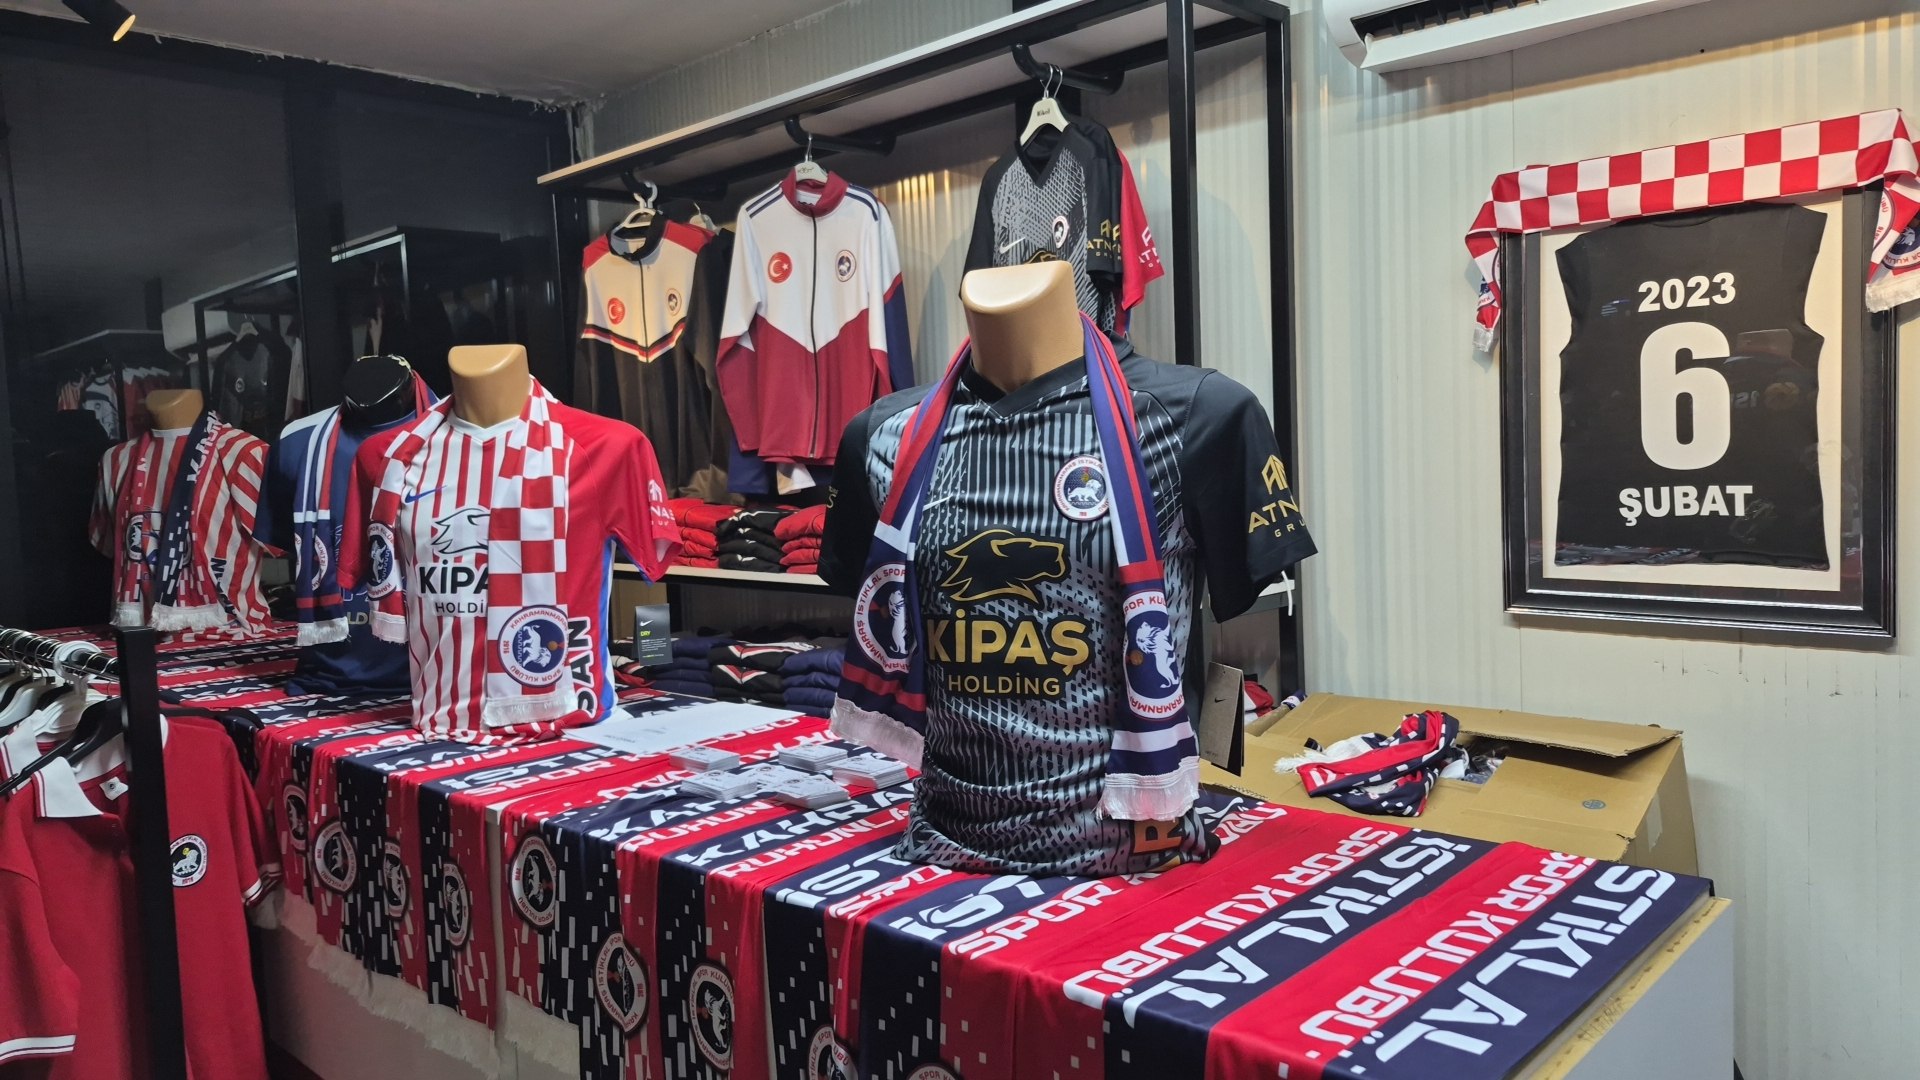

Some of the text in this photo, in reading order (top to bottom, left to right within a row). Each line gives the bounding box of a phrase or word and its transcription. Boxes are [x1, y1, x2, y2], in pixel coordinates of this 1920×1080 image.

[1637, 272, 1737, 313] 2023
[1640, 321, 1731, 471] 6
[1248, 495, 1300, 534] ATN
[1618, 485, 1753, 527] ŞUBAT
[418, 558, 489, 595] KİPA
[434, 599, 485, 614] HOLDİ
[926, 609, 1091, 675] KİPAŞ
[947, 674, 1061, 695] HOLDİNG
[462, 758, 617, 797] SPOR
[617, 799, 776, 853] RUHUN
[1271, 825, 1400, 886] SPOR
[948, 878, 1122, 961] SPOR
[1374, 864, 1677, 1063] STİKLAL
